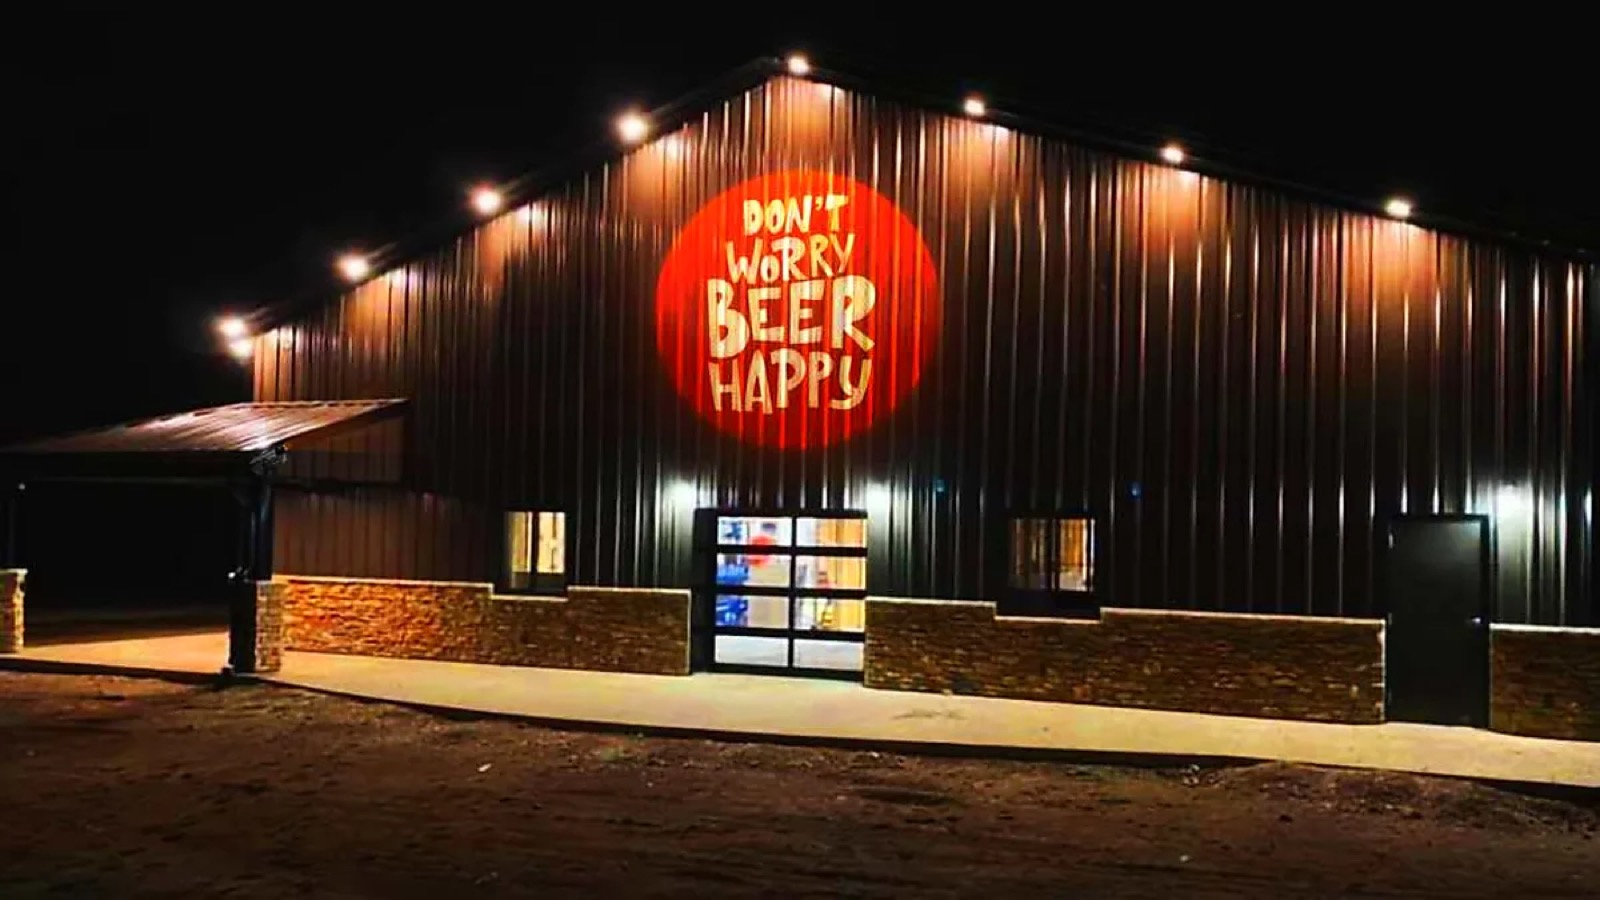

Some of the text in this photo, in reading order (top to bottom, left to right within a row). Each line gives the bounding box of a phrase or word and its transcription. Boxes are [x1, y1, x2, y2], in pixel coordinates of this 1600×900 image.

[743, 194, 849, 236] DON'T
[726, 232, 855, 285] WORRY
[707, 274, 876, 358] BEER
[708, 348, 873, 415] HAPPY
